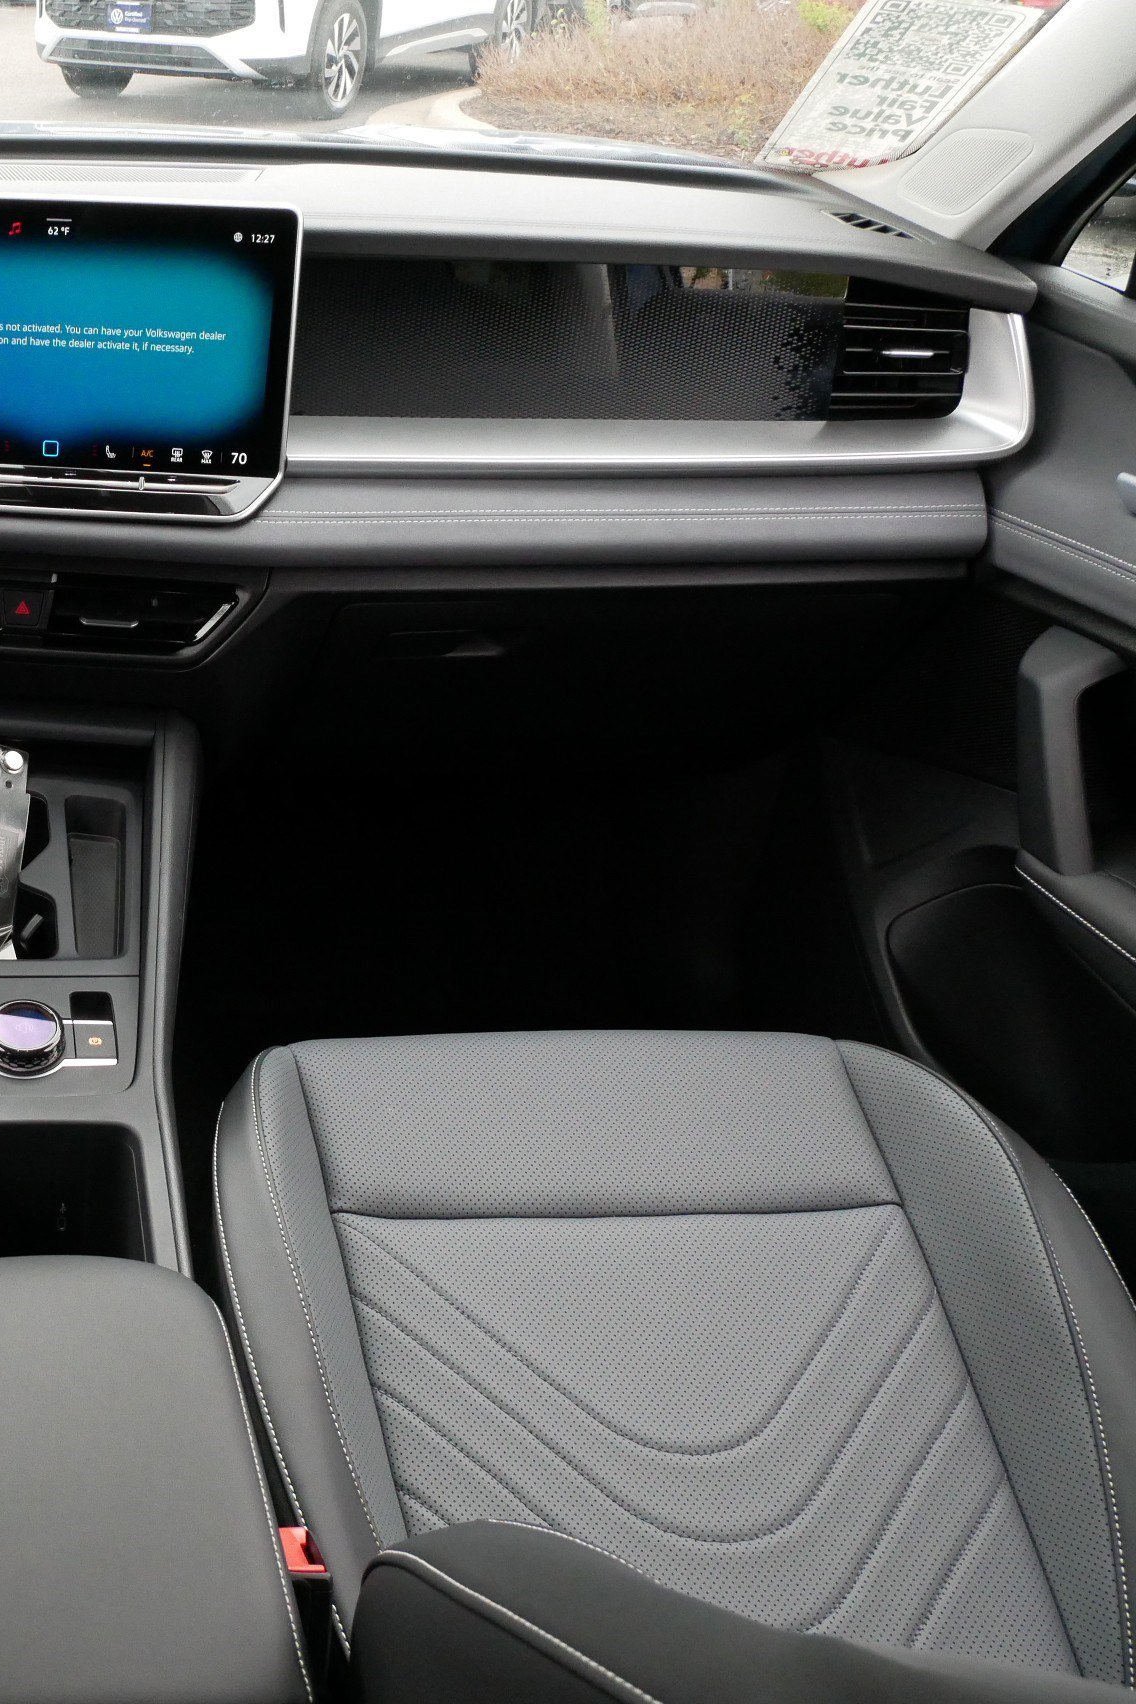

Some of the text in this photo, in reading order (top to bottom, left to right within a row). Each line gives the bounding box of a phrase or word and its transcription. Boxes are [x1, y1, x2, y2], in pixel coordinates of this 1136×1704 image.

[48, 226, 58, 236] 62
[251, 234, 275, 244] 12:27
[6, 323, 20, 332] not
[22, 324, 62, 334] activated.
[65, 325, 80, 334] You
[101, 326, 122, 336] have
[124, 329, 142, 338] your
[146, 328, 196, 340] Volkswagen
[199, 331, 226, 340] dealer
[11, 336, 28, 346] and
[30, 336, 50, 346] have
[52, 338, 66, 347] the
[69, 338, 94, 348] dealer
[98, 340, 130, 350] activate
[142, 342, 148, 350] if
[150, 343, 194, 354] necessary.
[231, 452, 247, 465] 70
